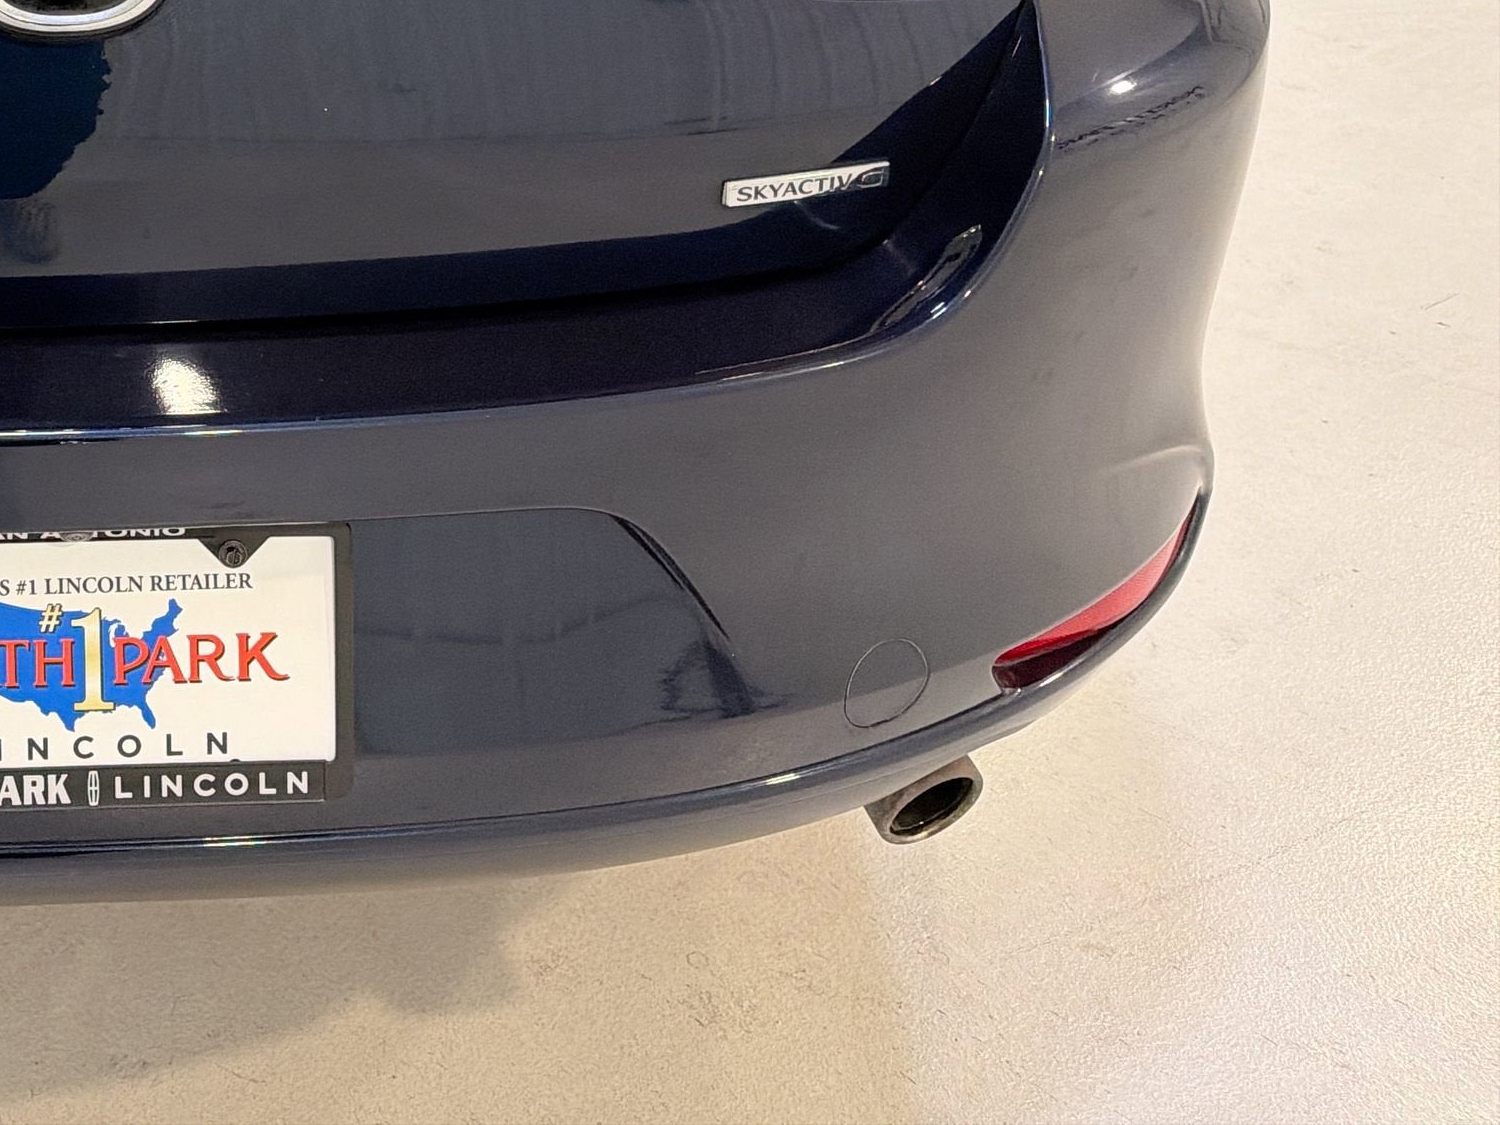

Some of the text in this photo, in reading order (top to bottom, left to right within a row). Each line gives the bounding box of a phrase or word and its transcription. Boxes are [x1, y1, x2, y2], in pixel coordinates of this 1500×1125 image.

[16, 578, 37, 595] #1
[44, 575, 144, 595] LINCOLN
[149, 572, 253, 592] RETAILER
[112, 631, 290, 685] PARK
[114, 770, 309, 799] LINCOLN
